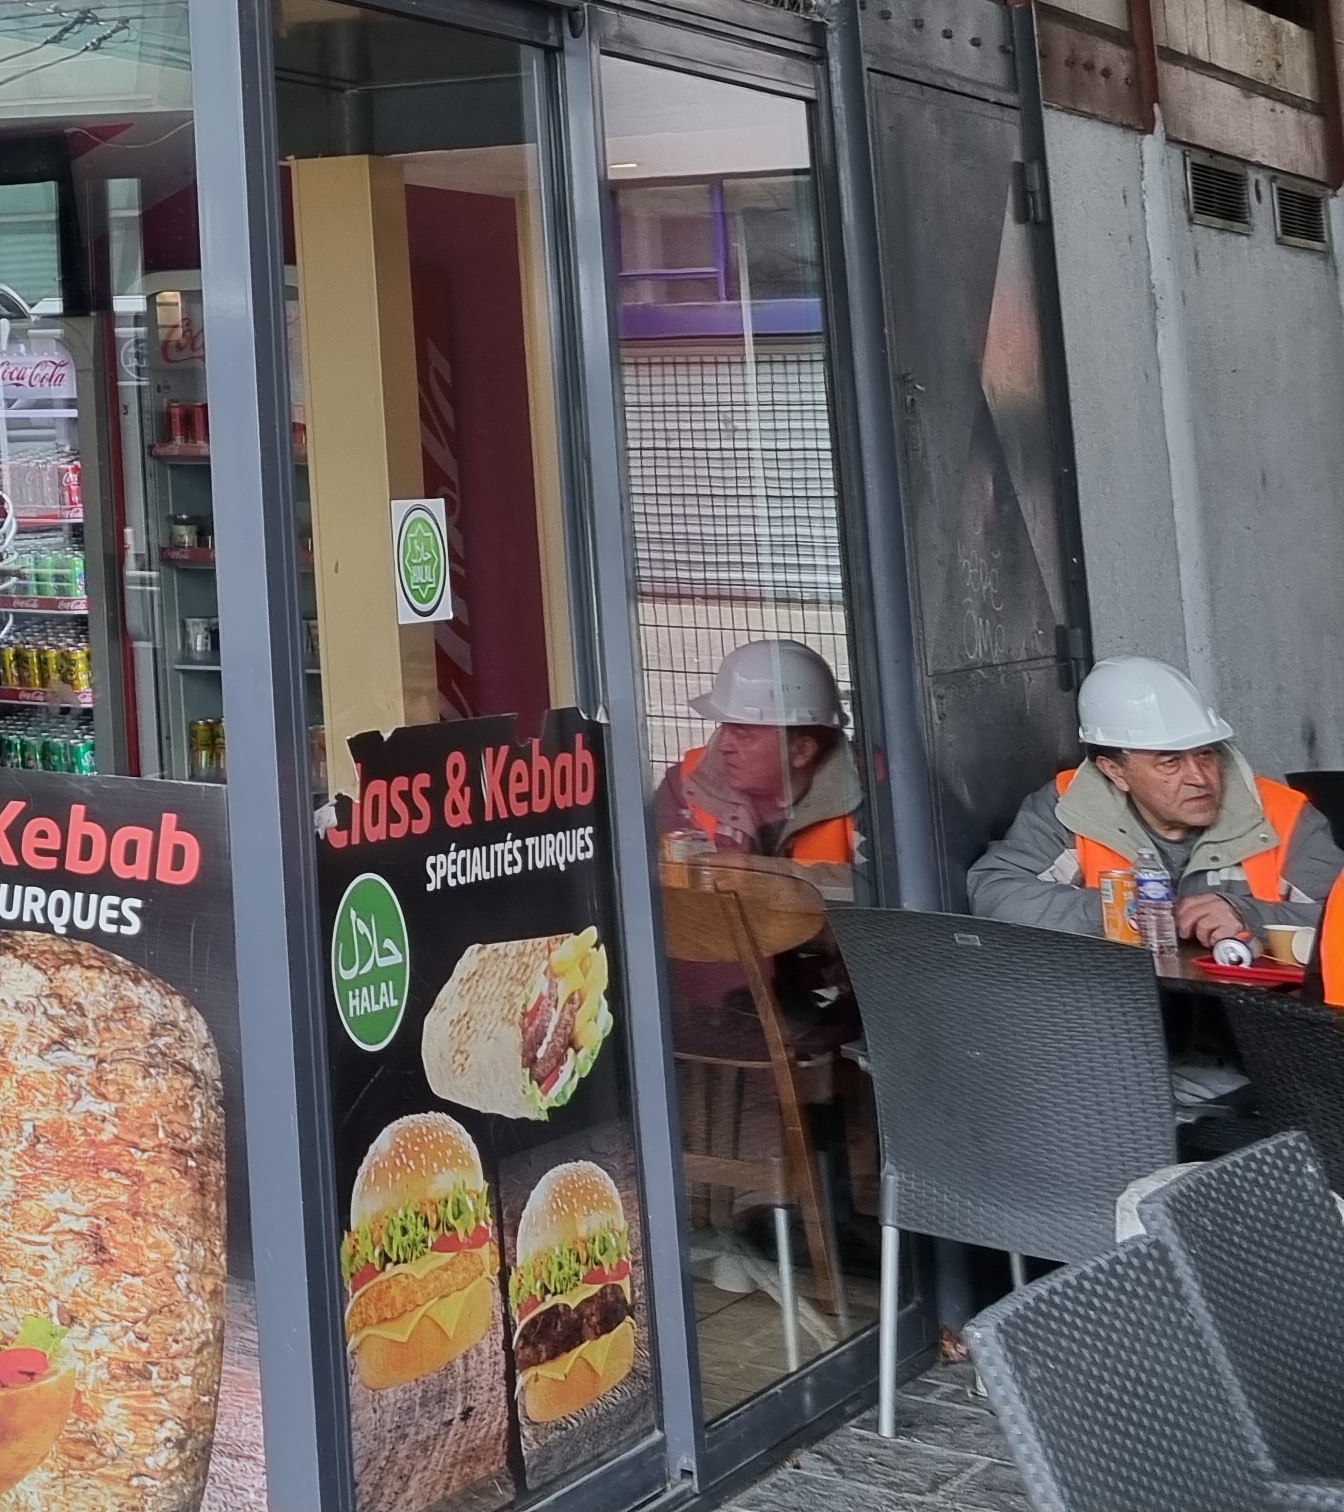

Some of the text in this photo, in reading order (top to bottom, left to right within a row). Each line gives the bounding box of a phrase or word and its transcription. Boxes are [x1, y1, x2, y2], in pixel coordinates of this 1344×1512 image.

[325, 733, 595, 849] lass & Kebab
[426, 825, 594, 892] SPÉCIALITÉS TURQUES
[348, 980, 398, 1018] HALAL
